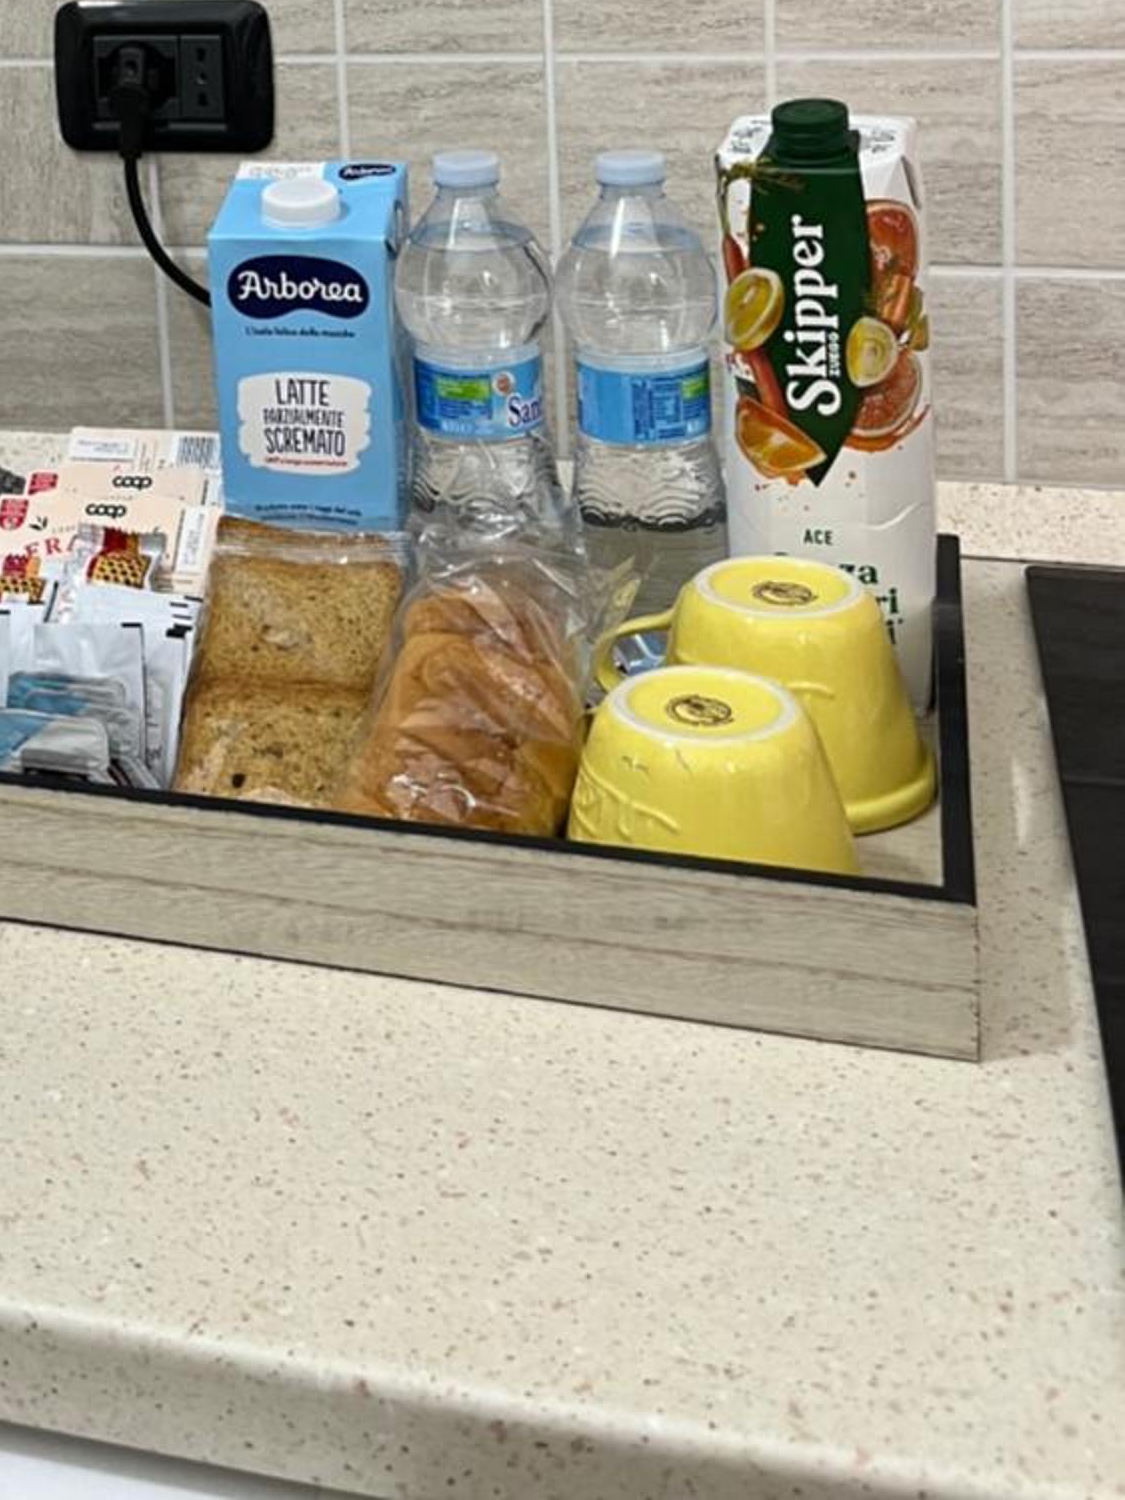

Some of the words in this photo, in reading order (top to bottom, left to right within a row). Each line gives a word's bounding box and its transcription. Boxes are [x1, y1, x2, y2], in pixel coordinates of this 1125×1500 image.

[236, 269, 364, 303] Arborea
[783, 213, 843, 417] Skipper
[275, 377, 331, 407] LATTE
[263, 407, 345, 429] PARZIALMENTE
[263, 426, 346, 457] SCREMATO
[112, 475, 153, 491] coop
[85, 502, 127, 519] coop
[803, 528, 833, 546] ACE
